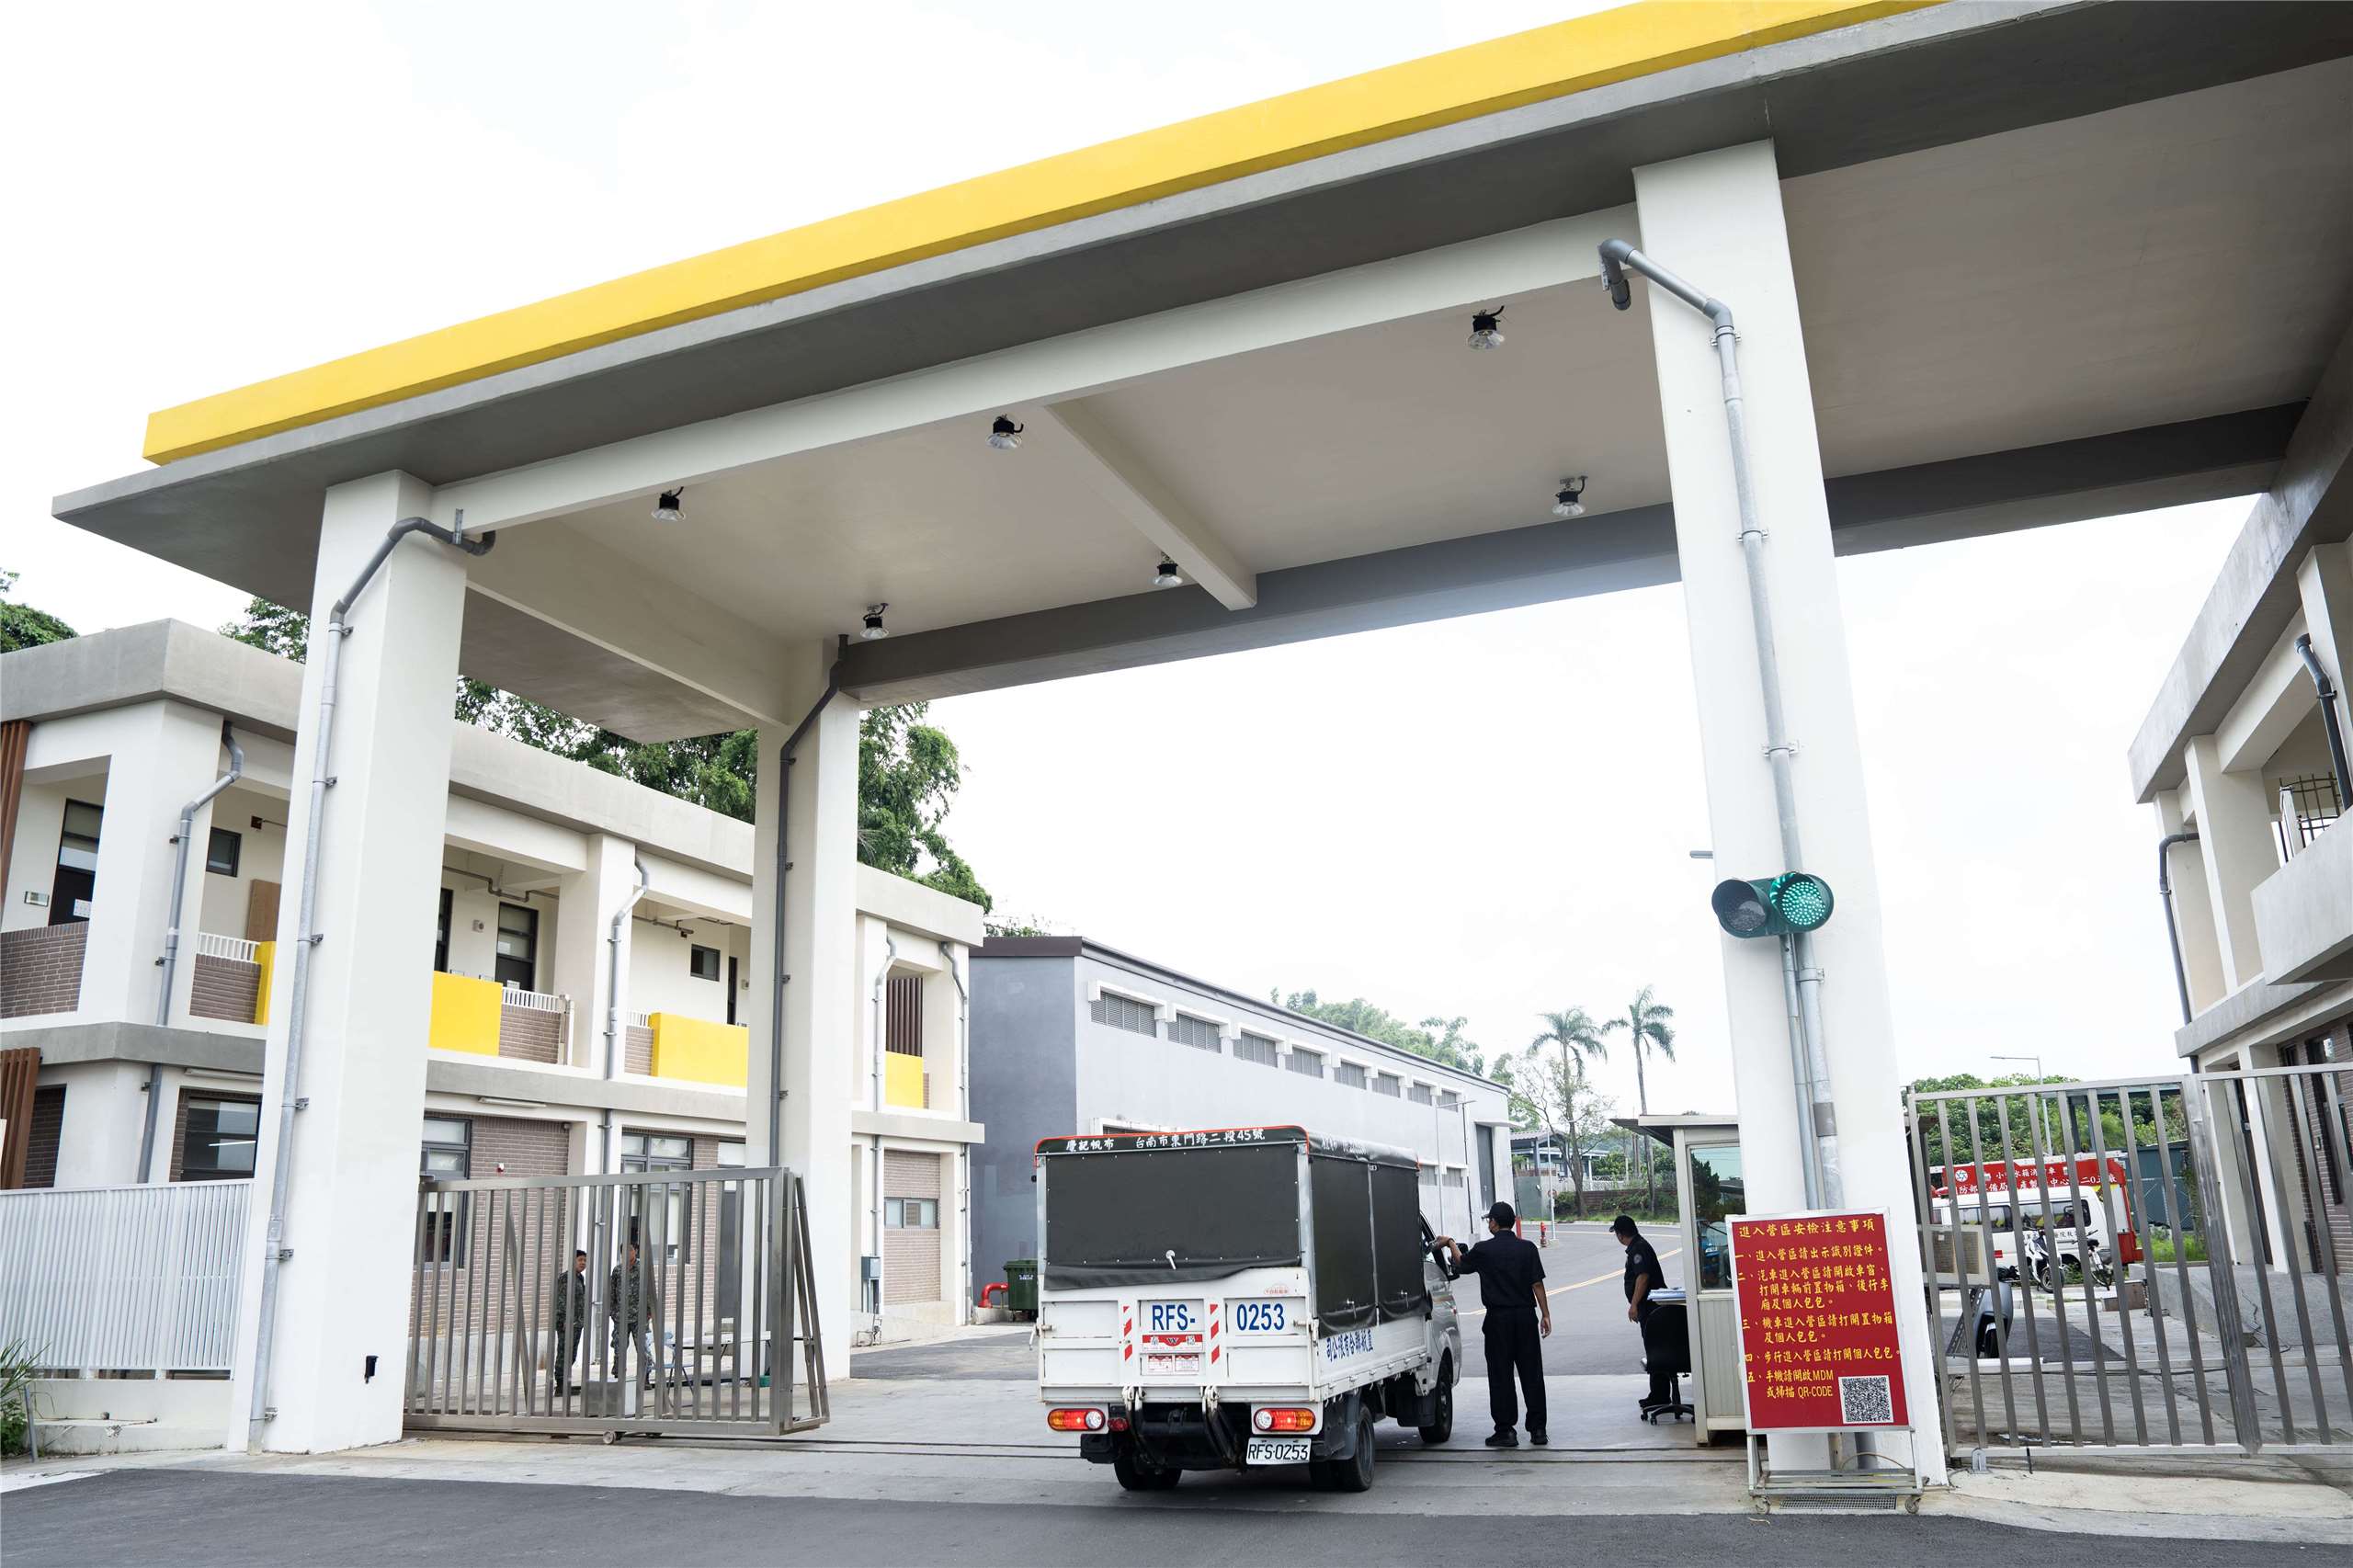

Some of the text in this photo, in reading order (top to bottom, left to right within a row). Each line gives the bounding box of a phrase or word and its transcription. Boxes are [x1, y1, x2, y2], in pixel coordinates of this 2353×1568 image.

[1738, 1218, 1875, 1238] 進入營區安檢注意事項
[1236, 1303, 1285, 1331] 0253
[1797, 1385, 1834, 1399] QR-CODE
